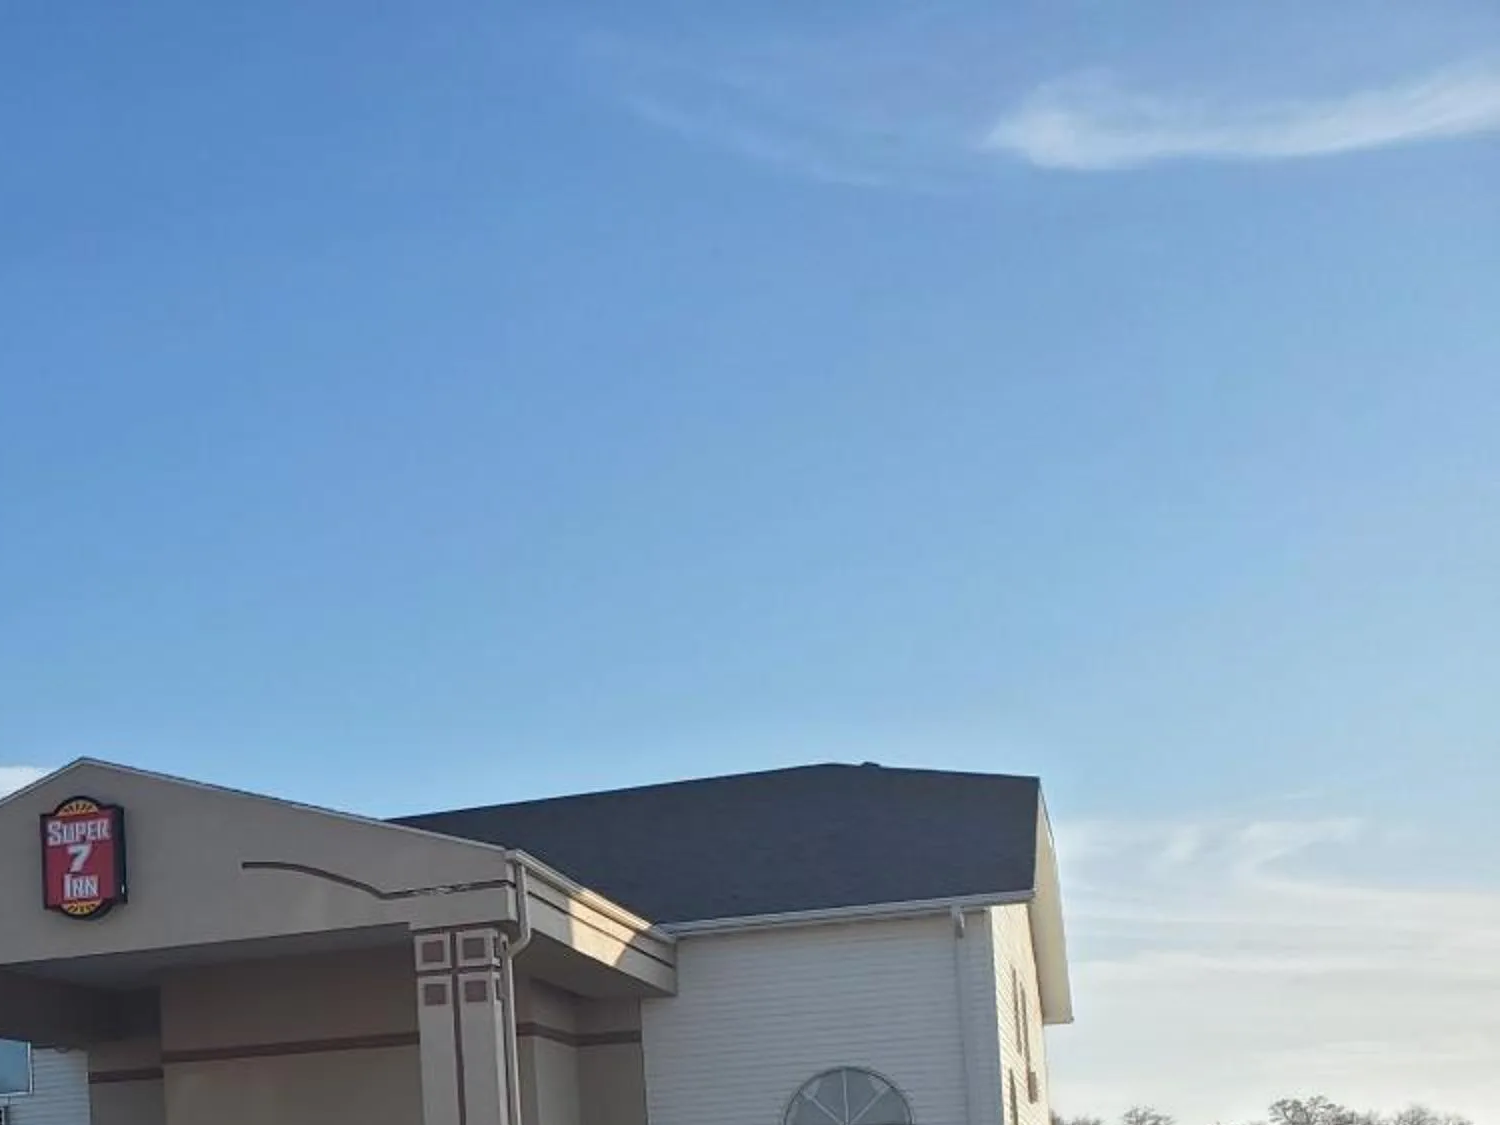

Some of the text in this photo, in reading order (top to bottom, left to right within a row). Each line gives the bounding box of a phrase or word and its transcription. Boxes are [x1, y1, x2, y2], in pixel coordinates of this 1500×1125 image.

[47, 818, 112, 847] SUPER
[67, 844, 92, 872] 7
[63, 874, 99, 900] INN
